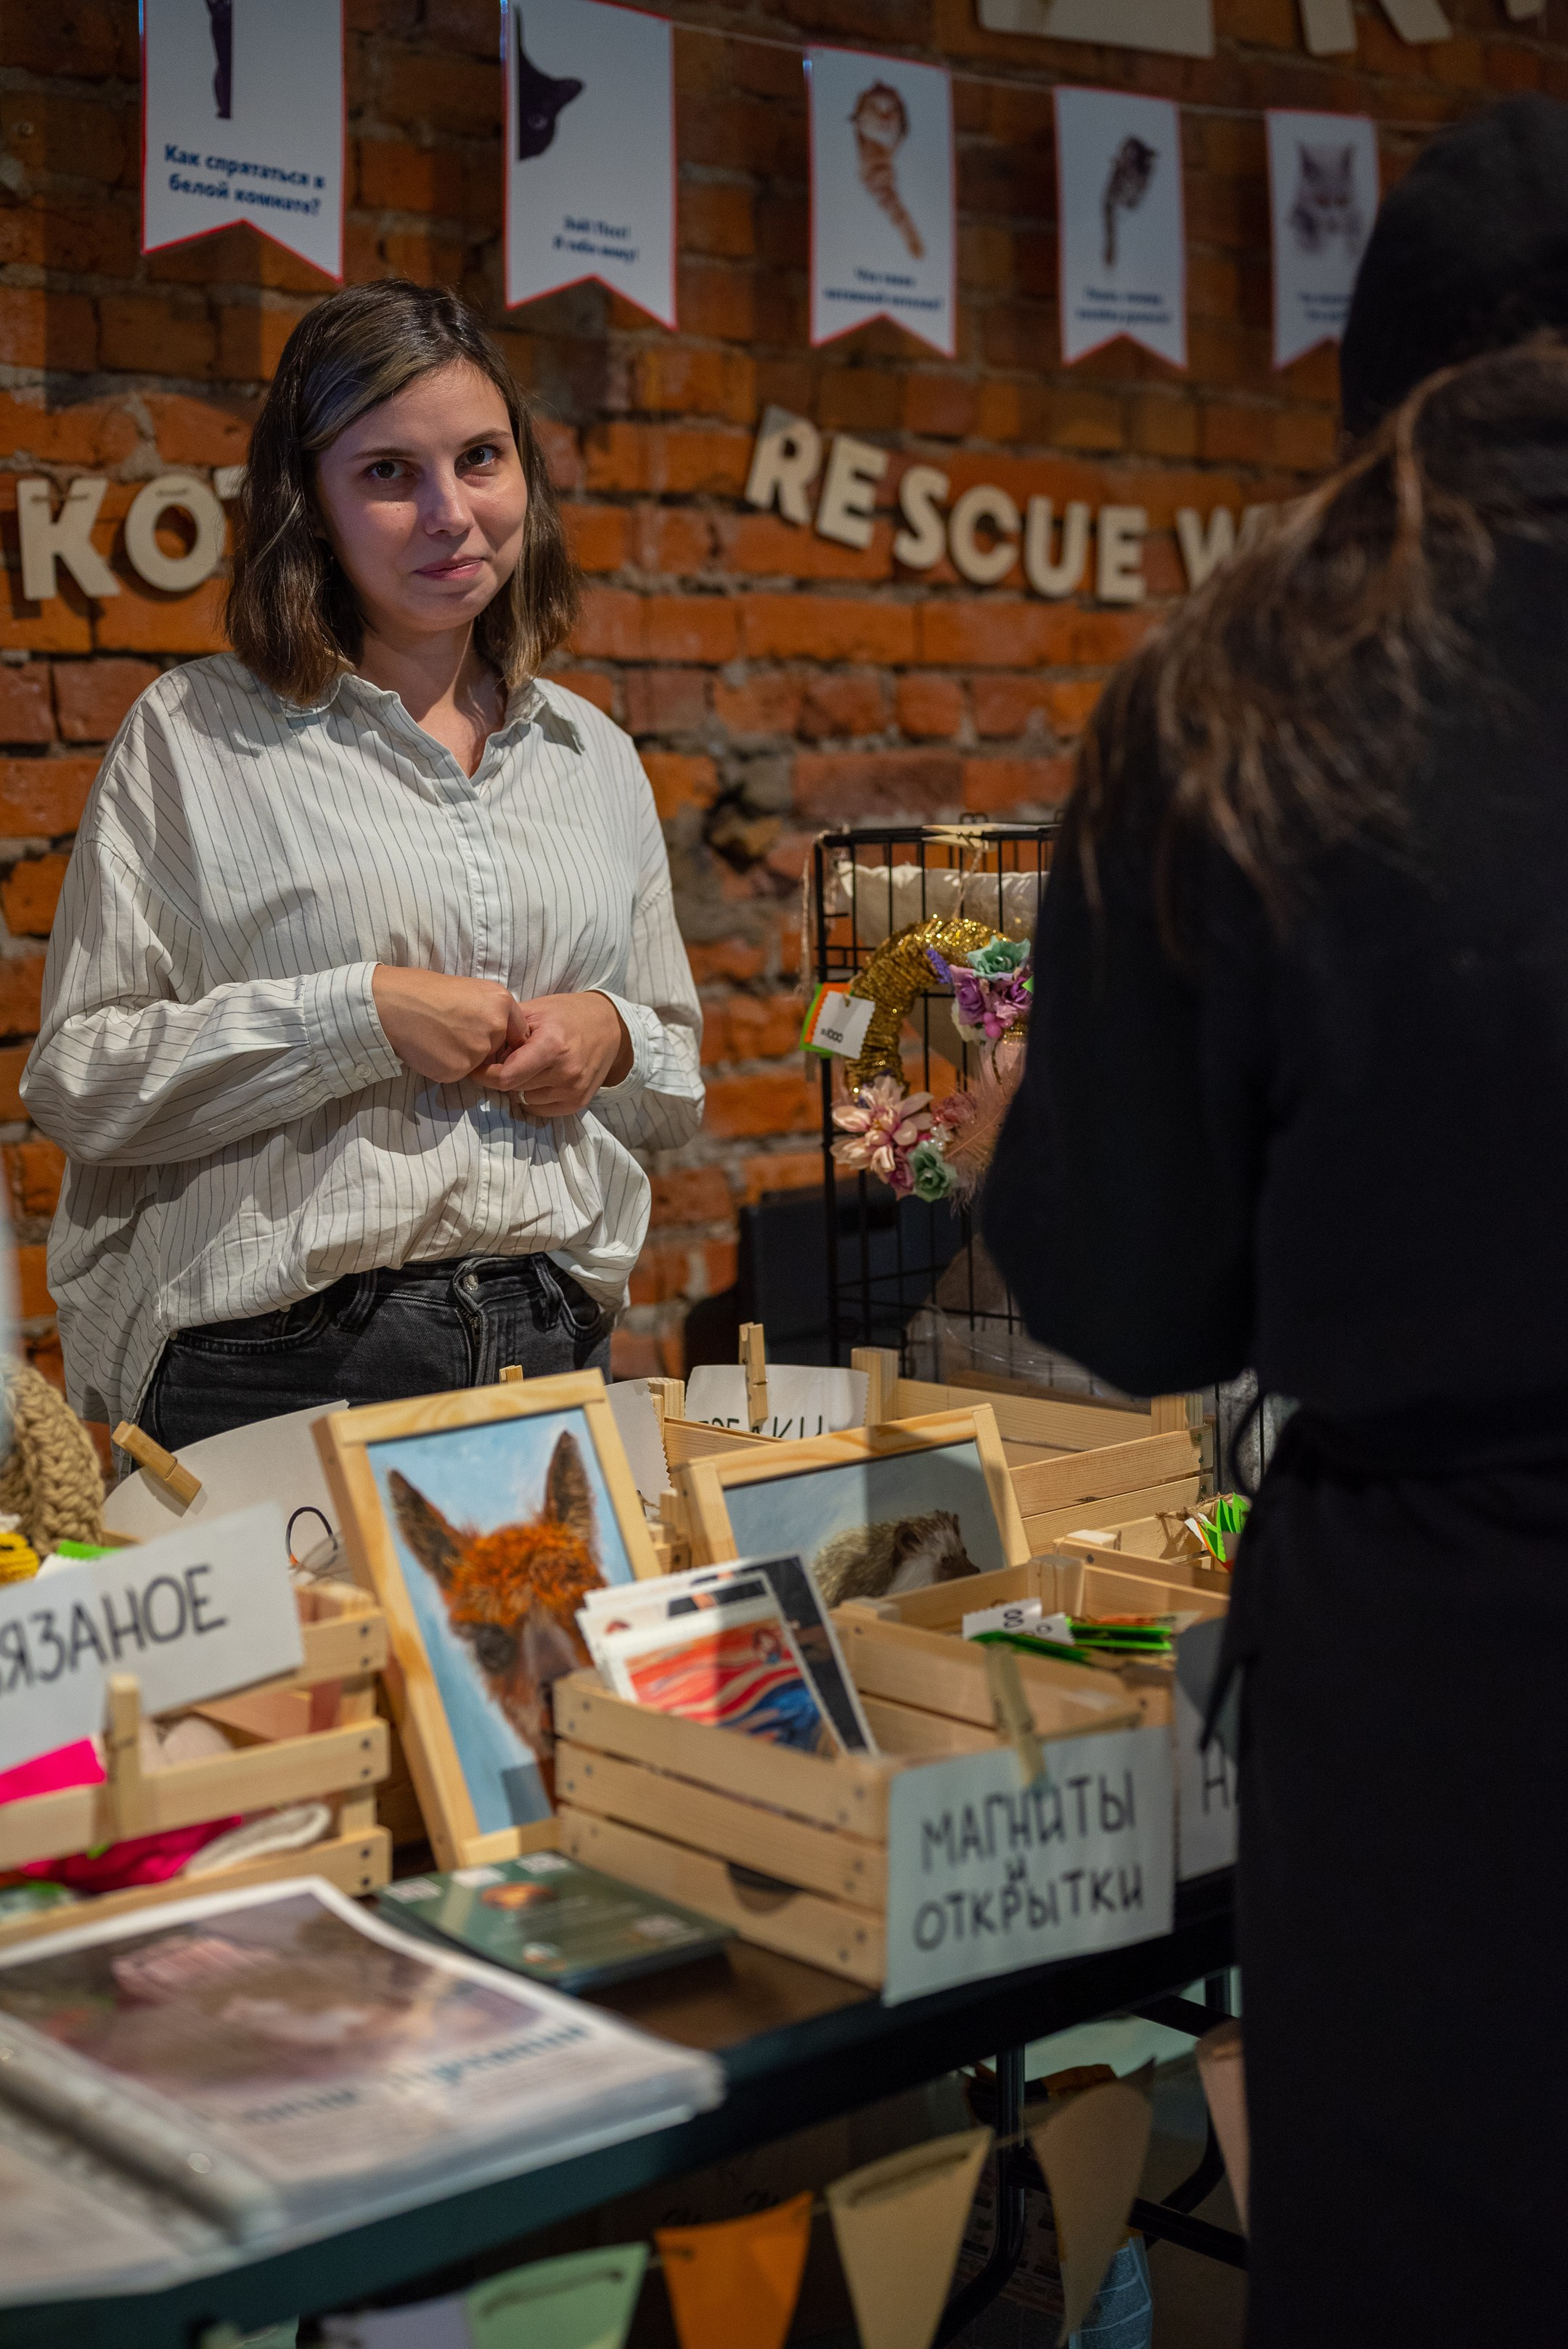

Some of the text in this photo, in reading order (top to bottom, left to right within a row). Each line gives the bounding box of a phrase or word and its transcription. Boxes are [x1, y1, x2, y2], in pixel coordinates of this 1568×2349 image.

[164, 143, 200, 167] Как
[205, 155, 310, 185] спрятаться
[168, 173, 322, 216] белой комнате?
[16, 465, 248, 602] КО
[745, 403, 1148, 602] RESCUE
[0, 1564, 229, 1694] ЯЗАНОЕ
[920, 1770, 1137, 1874] МАГНИТЫ
[912, 1861, 1144, 1953] ОТКРЫТКИ
